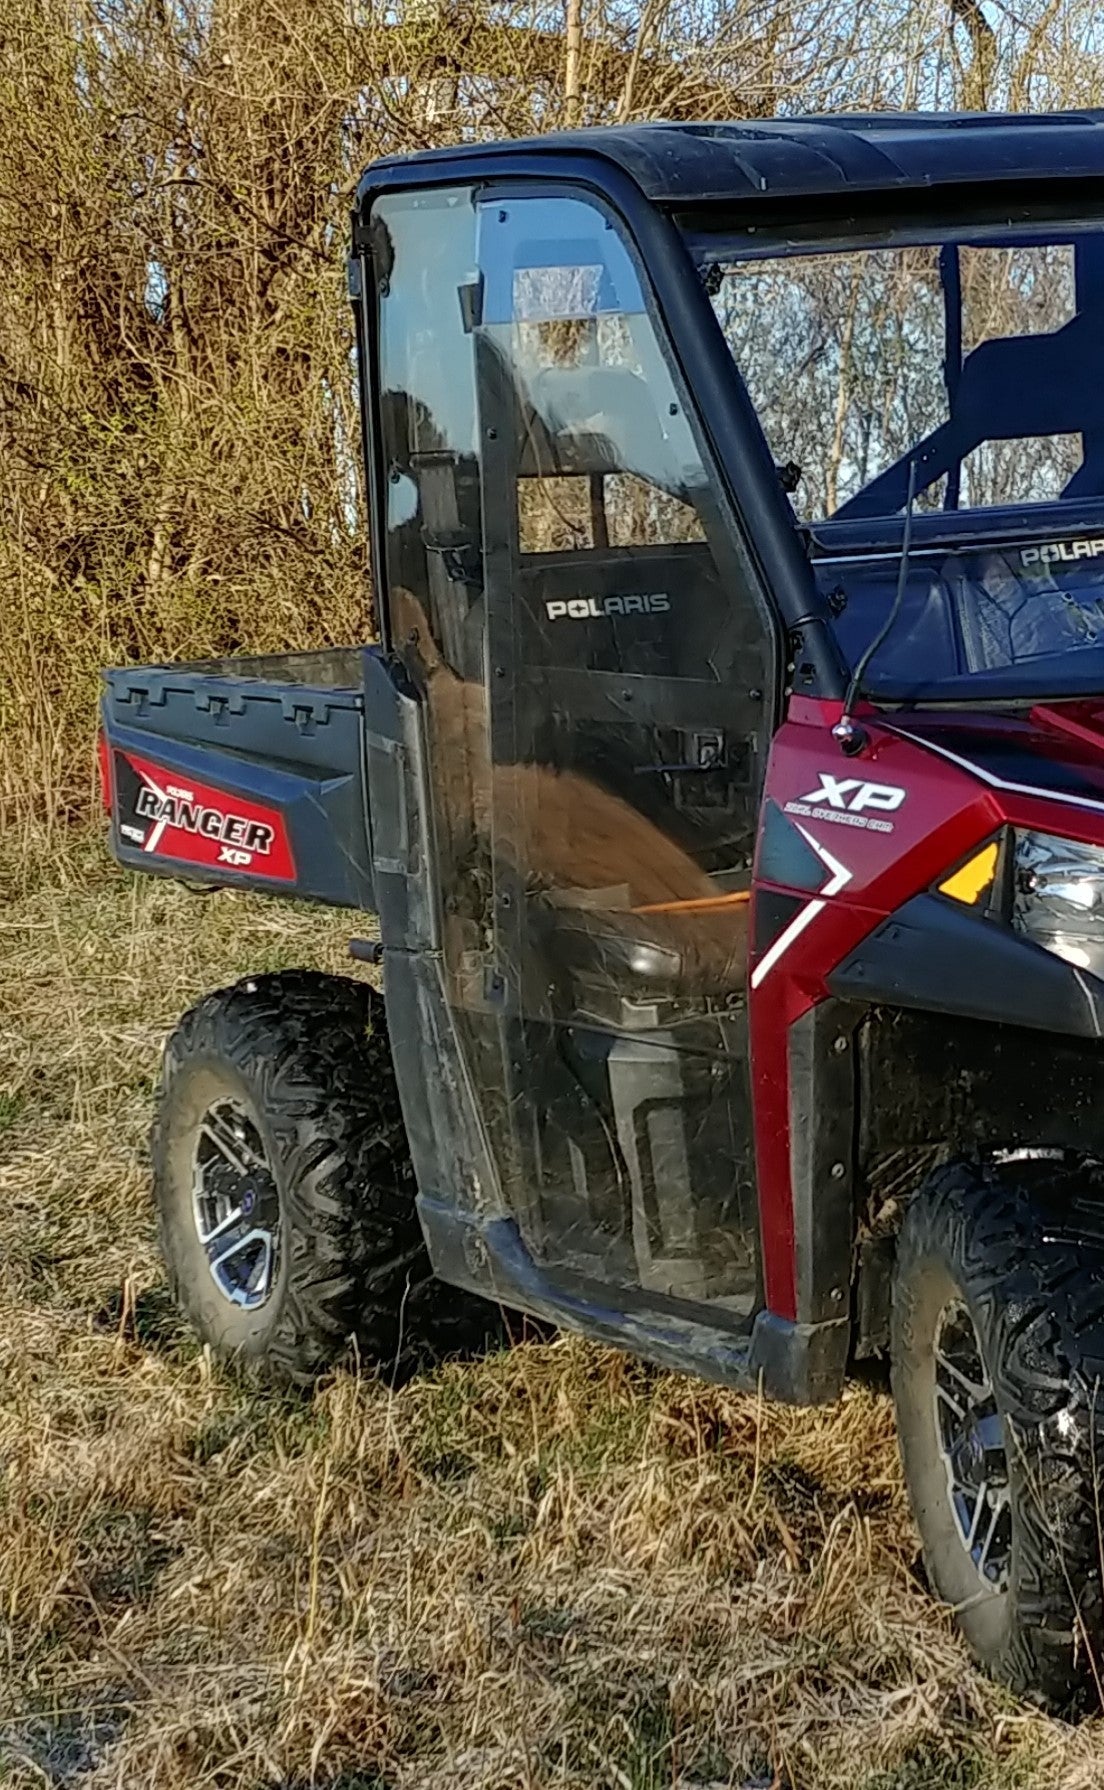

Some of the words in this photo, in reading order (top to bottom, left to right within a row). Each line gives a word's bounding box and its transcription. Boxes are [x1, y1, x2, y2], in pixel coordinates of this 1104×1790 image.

[546, 593, 671, 620] POLARIS
[799, 773, 906, 811] XP
[135, 786, 275, 855] RANGER
[217, 846, 252, 866] XP
